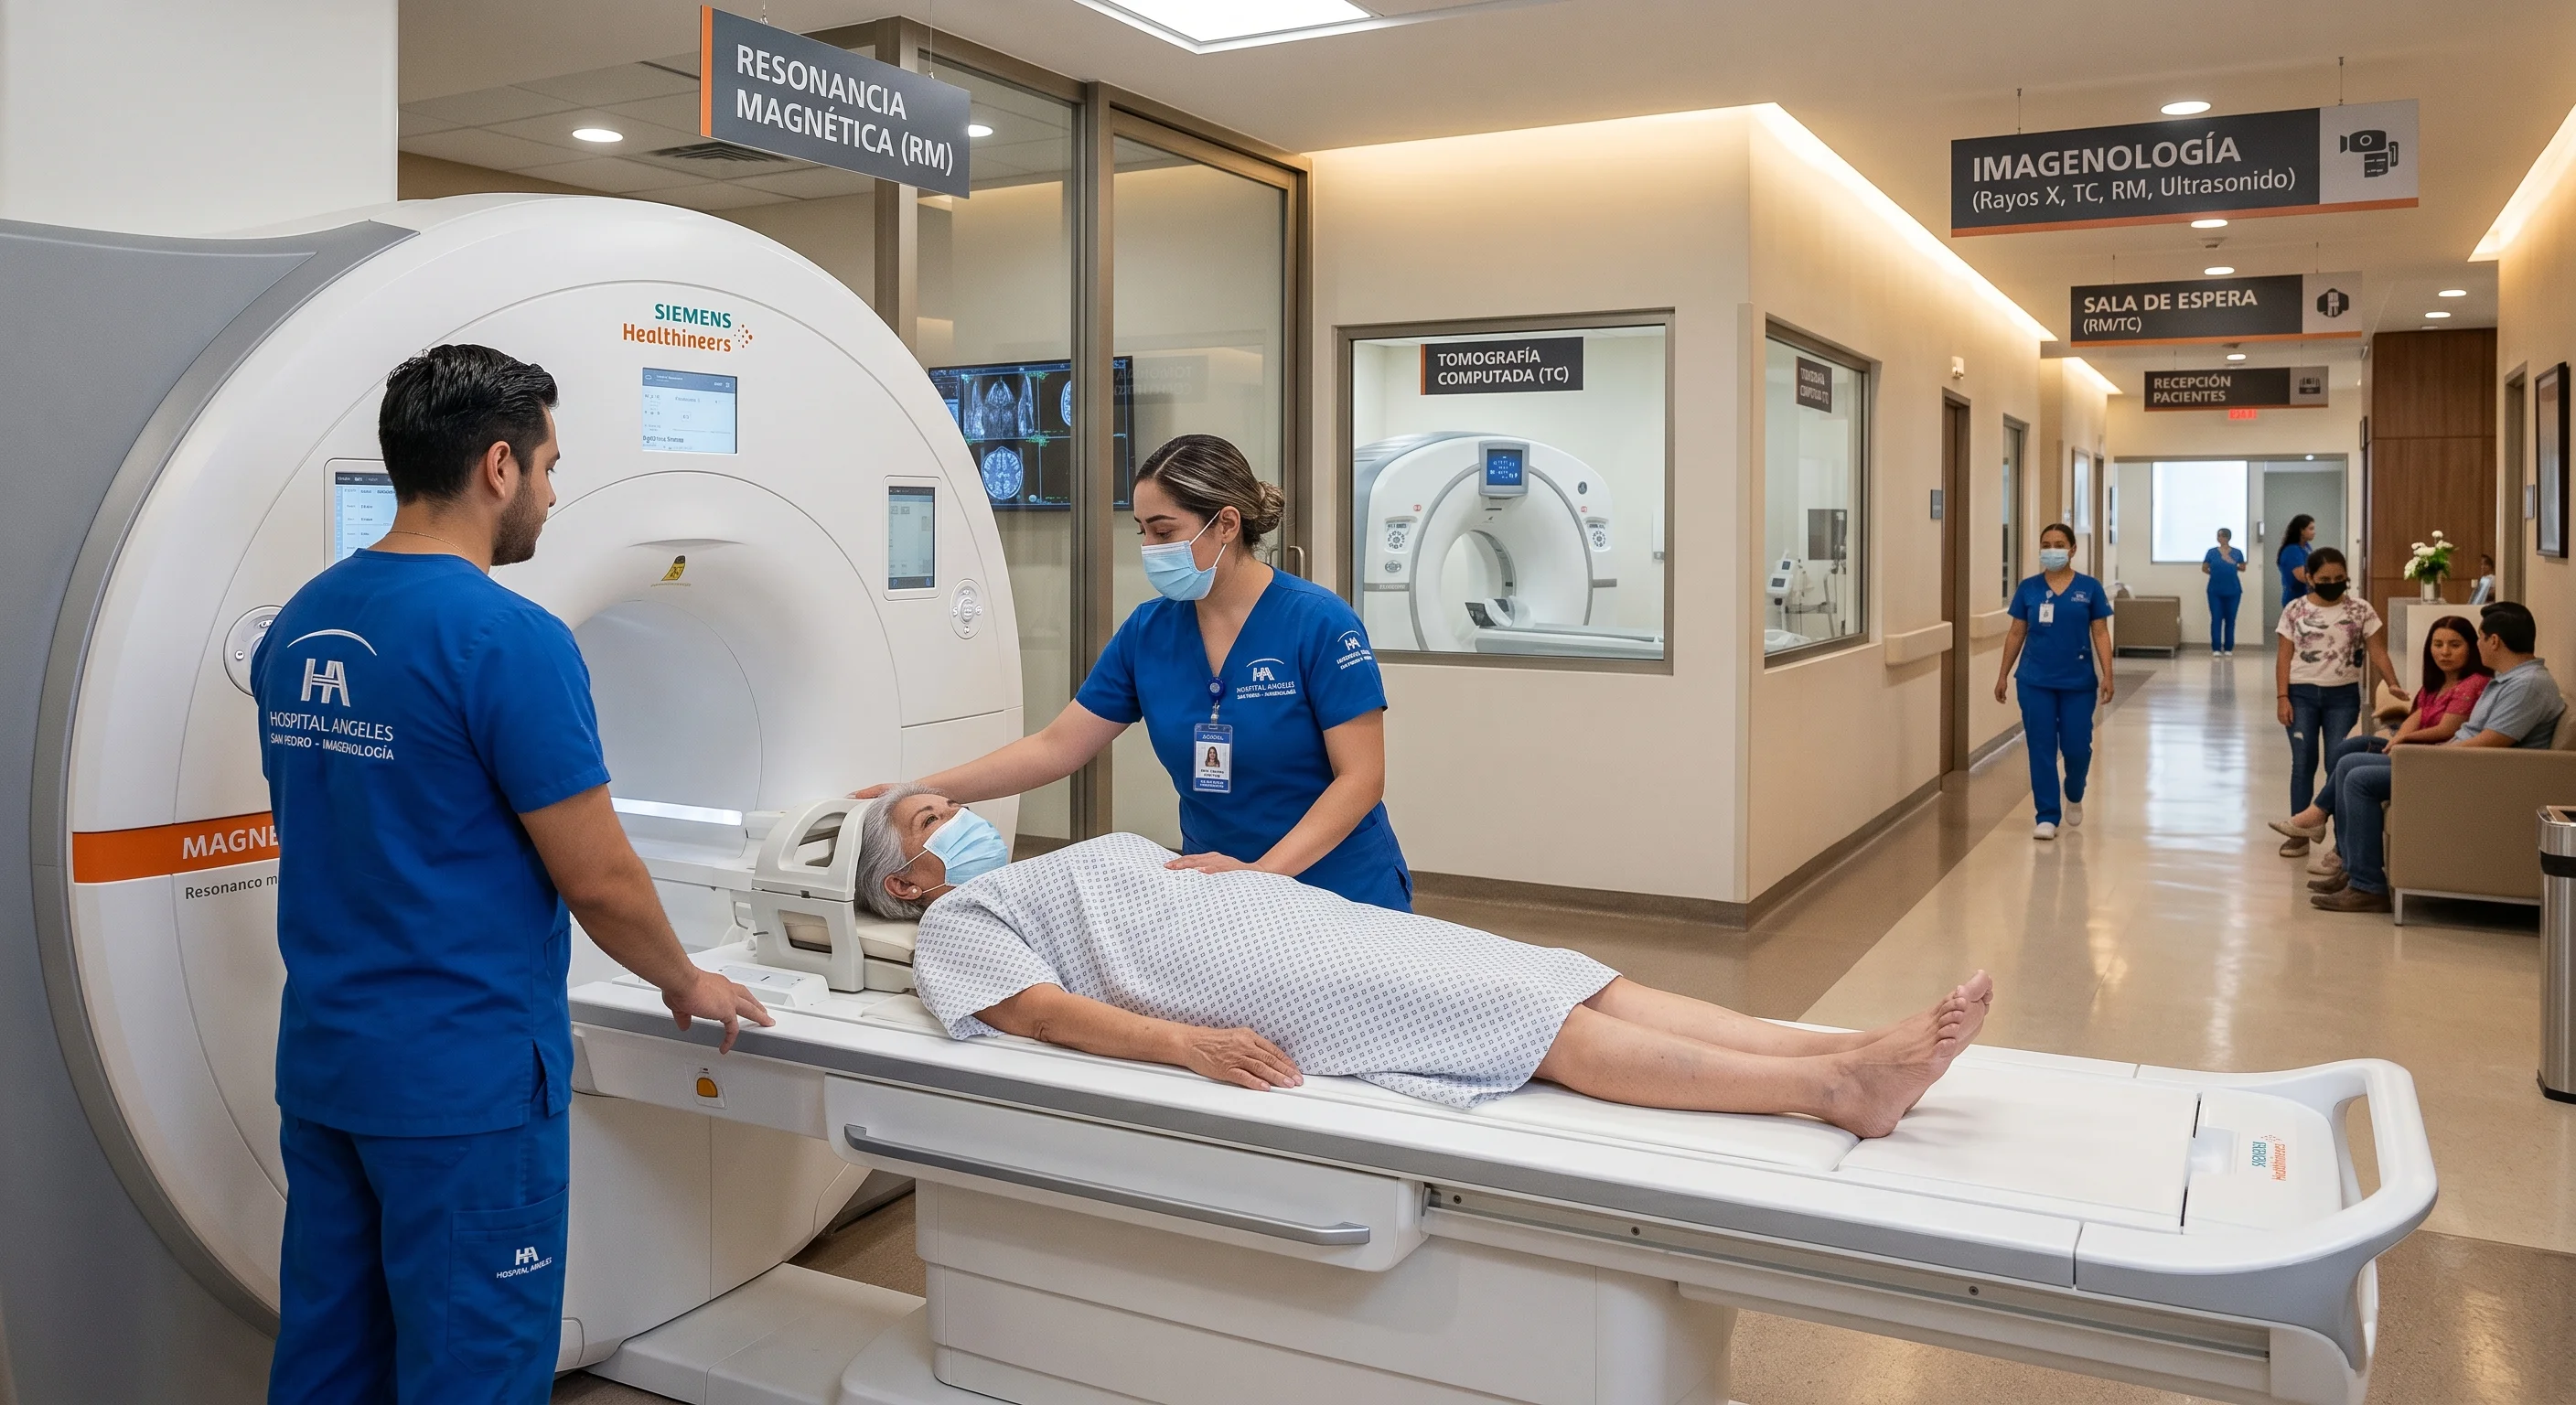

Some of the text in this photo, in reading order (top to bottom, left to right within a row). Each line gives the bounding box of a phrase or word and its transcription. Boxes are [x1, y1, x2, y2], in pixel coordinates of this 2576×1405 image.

[737, 44, 907, 120] RESONANCIA
[737, 89, 953, 177] MAGNÉTICA (RM)
[1973, 132, 2241, 182] IMAGENOLOGÍA
[1972, 166, 2296, 213] (Rayos X, TC, RM, Ultrasonido)
[2084, 289, 2258, 314] SALA DE ESPERA
[655, 304, 732, 328] SIEMENS
[2083, 316, 2141, 335] (RM/TC)
[623, 323, 732, 352] Healthineers
[1437, 347, 1540, 367] TOMOGRAFÍA
[1437, 366, 1569, 385] COMPUTADA (TC)
[2153, 373, 2231, 389] RECEPCIÓN
[2153, 391, 2226, 402] PACIENTES
[270, 712, 394, 742] HOSPITAL ANGELES
[186, 878, 262, 899] Resonanco
